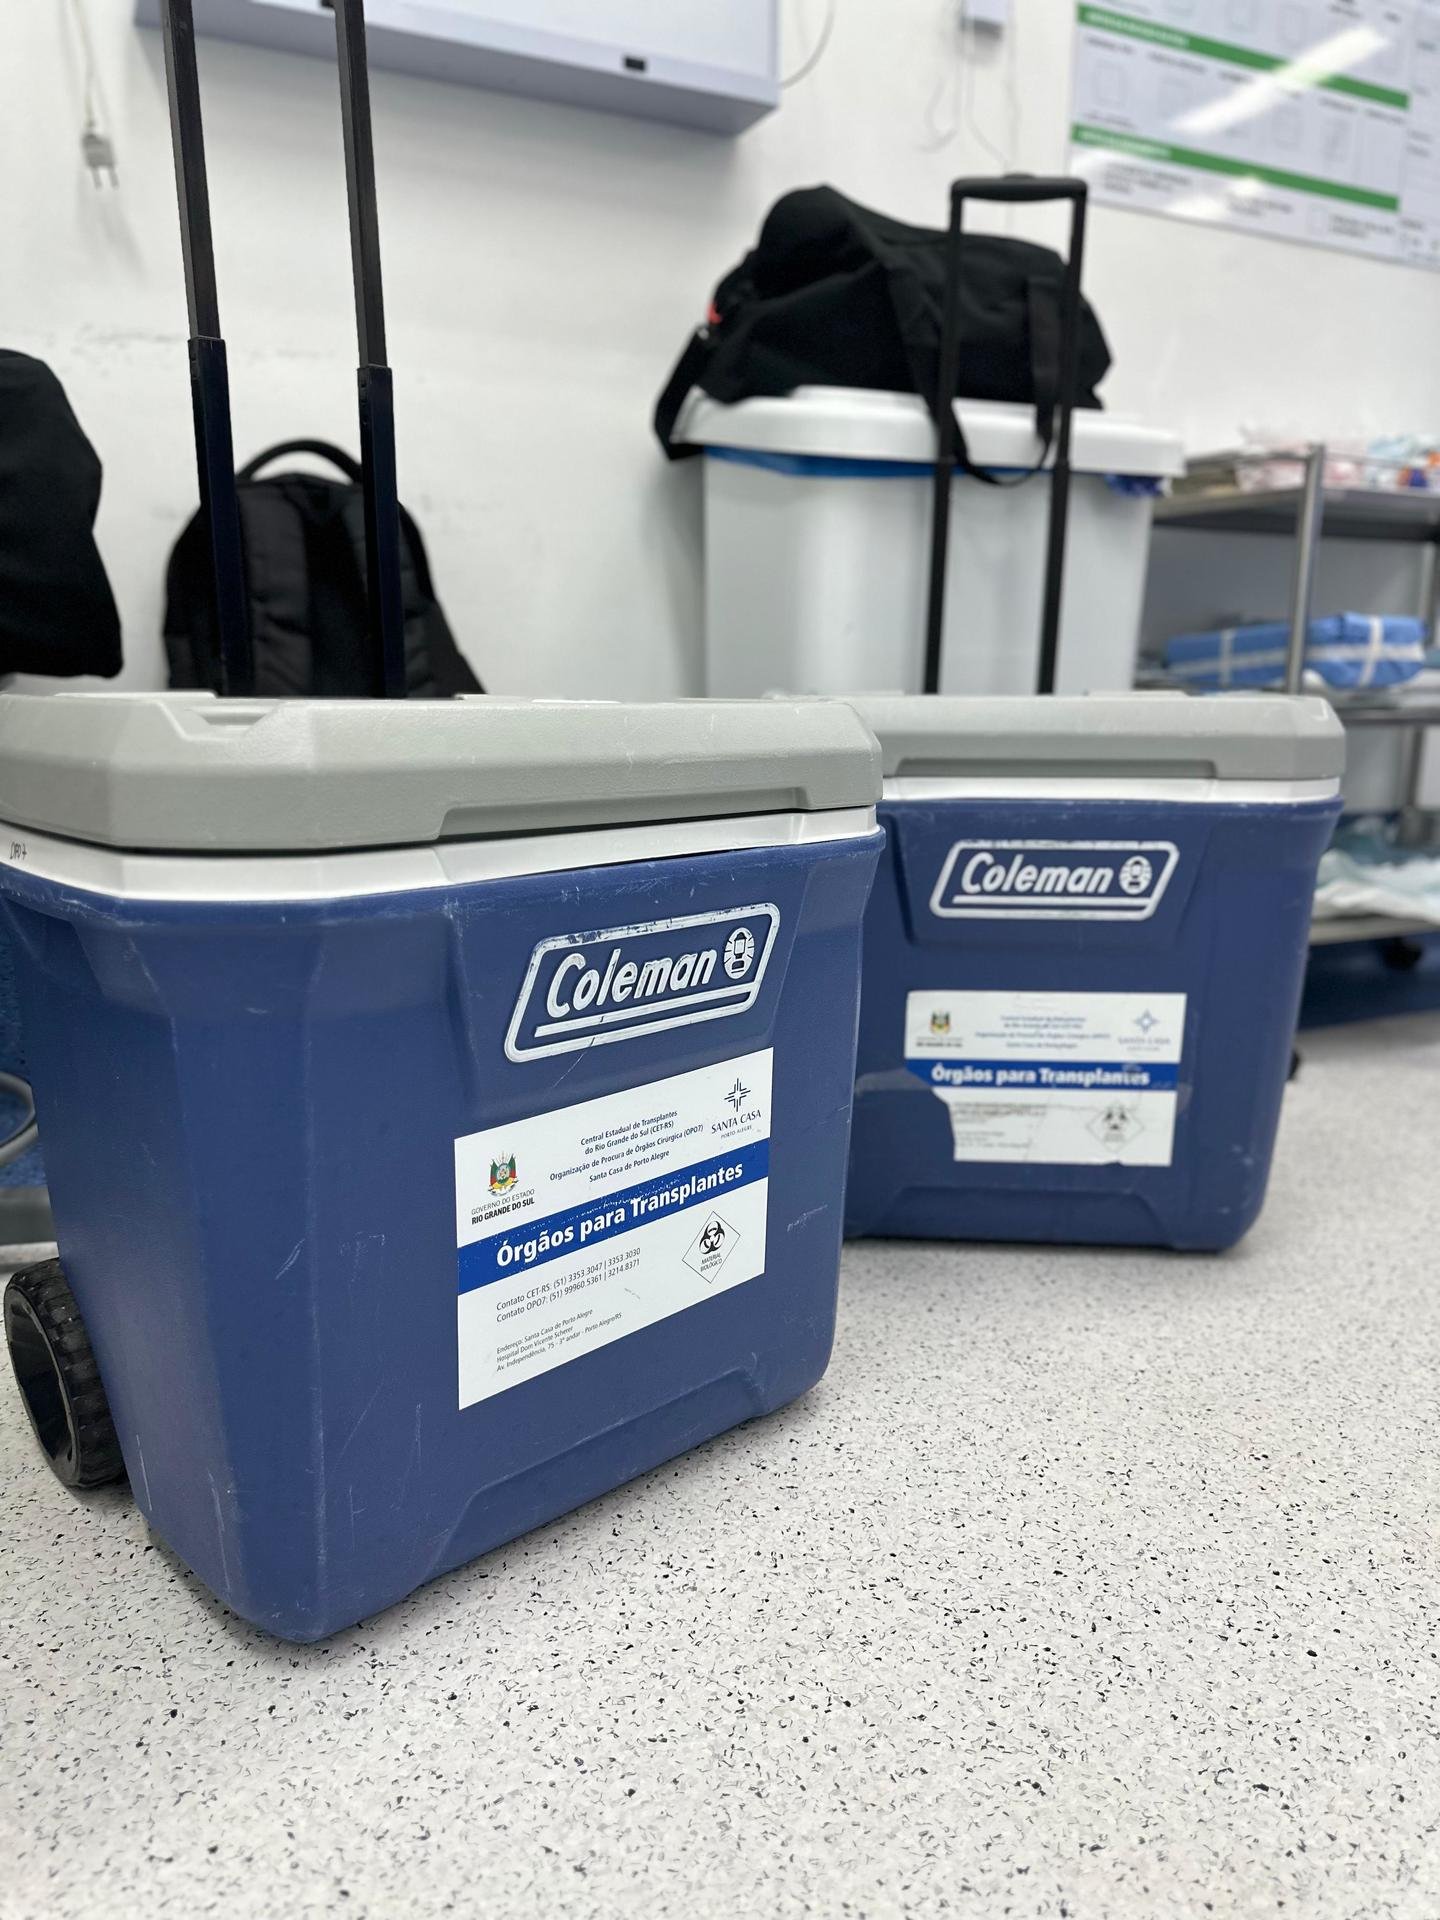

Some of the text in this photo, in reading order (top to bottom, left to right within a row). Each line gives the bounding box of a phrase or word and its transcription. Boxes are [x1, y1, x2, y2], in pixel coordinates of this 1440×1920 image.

[961, 851, 1115, 894] Coleman
[546, 948, 718, 1019] Coleman
[931, 1062, 1150, 1087] Órgãos para Transplantes
[580, 1110, 678, 1146] Central Estadual de Transplantes
[584, 1120, 675, 1155] do Rio Grande do Sul (CET-RS)
[711, 1109, 762, 1135] SANTA CASA
[720, 1124, 753, 1139] PORTO ALEGRE
[549, 1123, 704, 1181] Organização de Procura de Órgãos Cirúrgica (OPO7)
[589, 1150, 670, 1183] Santa Casa de Porto Alegre
[471, 1188, 535, 1215] GOVERNO DO ESTADO
[471, 1196, 535, 1225] RIO GRANDE DO SUL
[496, 1163, 744, 1267] Órgãos para Transplantes
[701, 1252, 722, 1265] MATERIAL
[496, 1306, 525, 1323] Contato
[549, 1289, 563, 1302] (51)
[563, 1273, 602, 1296] 99960.5361
[607, 1257, 640, 1278] 3214.8371
[496, 1294, 525, 1311] Contato
[553, 1275, 567, 1290] (51)
[524, 1331, 540, 1343] Santa
[540, 1326, 554, 1336] Casa
[554, 1321, 562, 1330] de
[562, 1316, 576, 1326] Porto
[576, 1309, 593, 1320] Alegre
[547, 1341, 555, 1350] 75
[565, 1331, 580, 1342] andar
[584, 1323, 599, 1334] Porto
[496, 1326, 573, 1363] Hospital Dom Vicente Scherer
